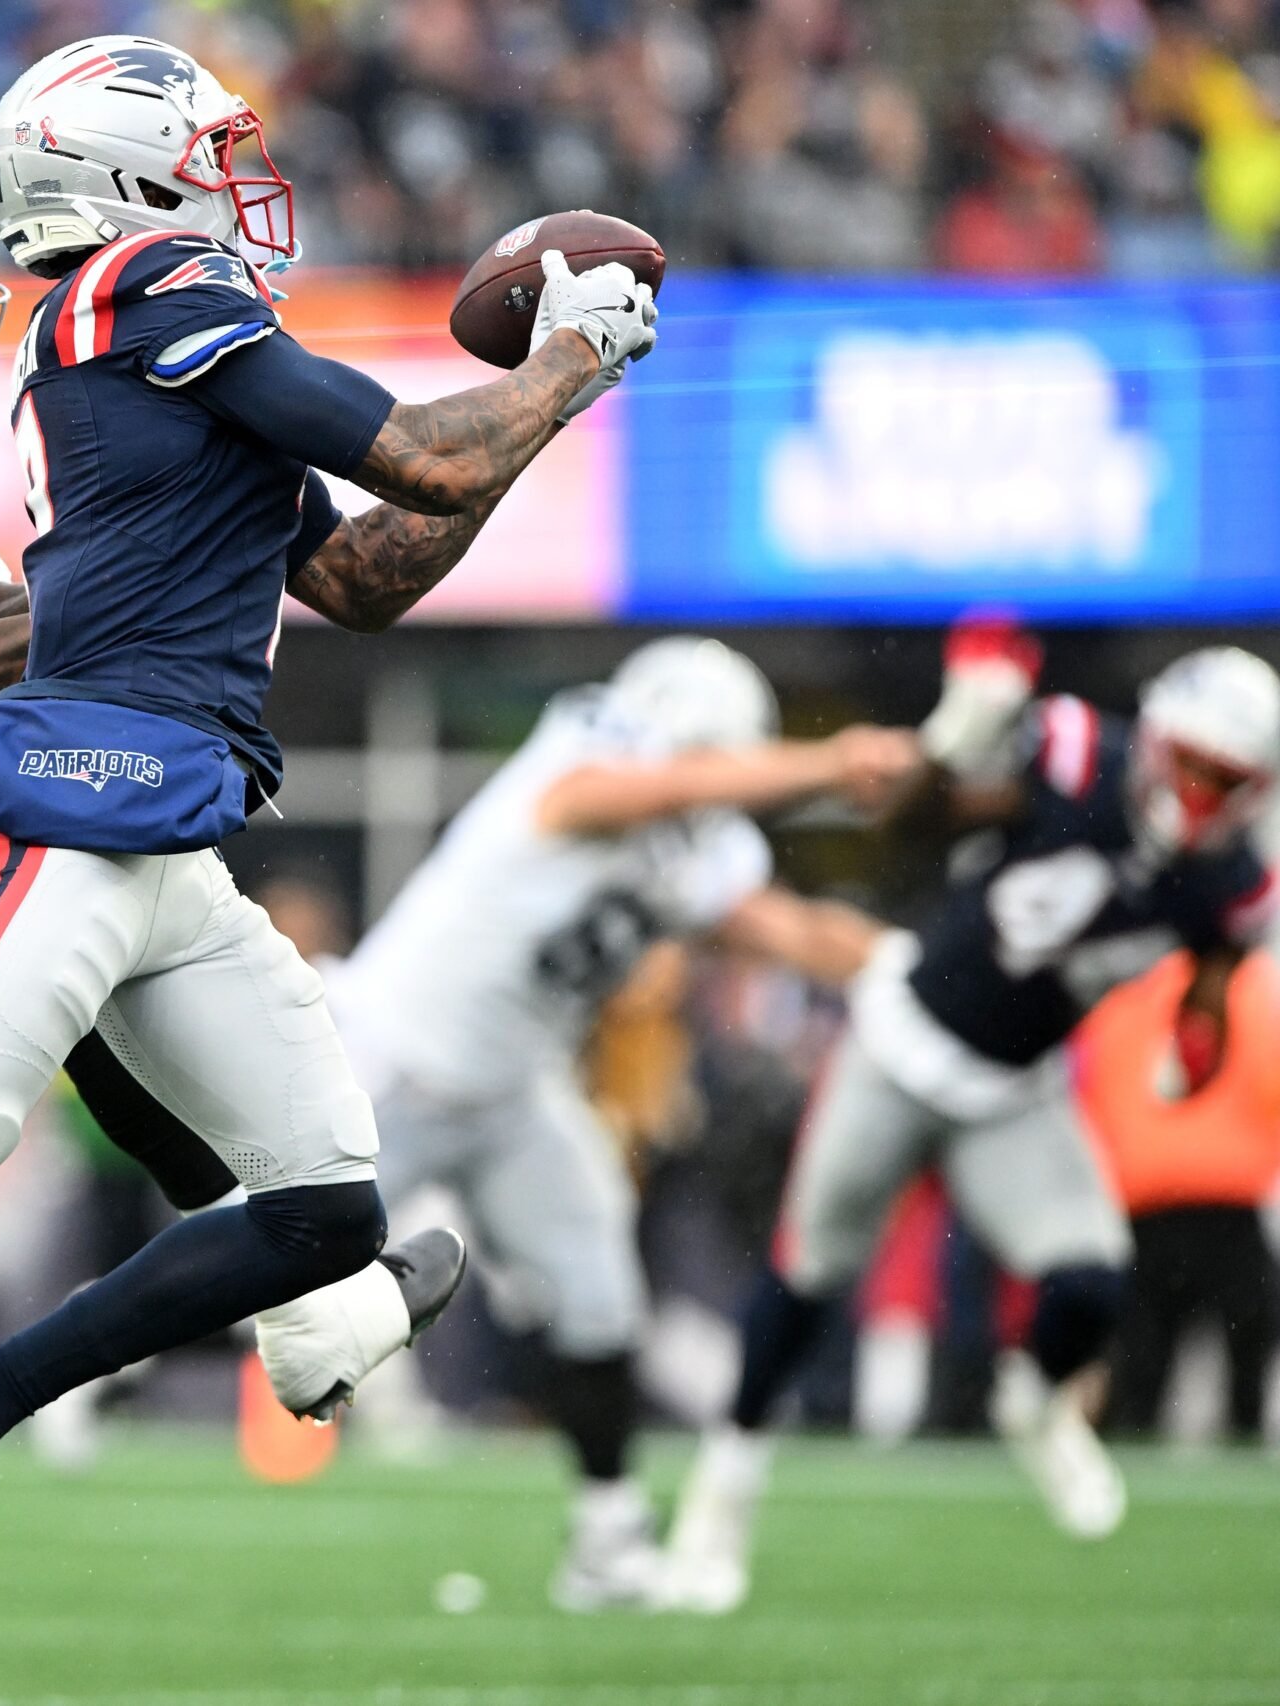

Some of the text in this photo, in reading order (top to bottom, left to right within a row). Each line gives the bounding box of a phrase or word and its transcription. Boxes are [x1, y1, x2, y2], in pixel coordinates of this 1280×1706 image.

[16, 131, 29, 143] NFL
[500, 226, 531, 250] NFL
[18, 750, 164, 788] PATRIOTS
